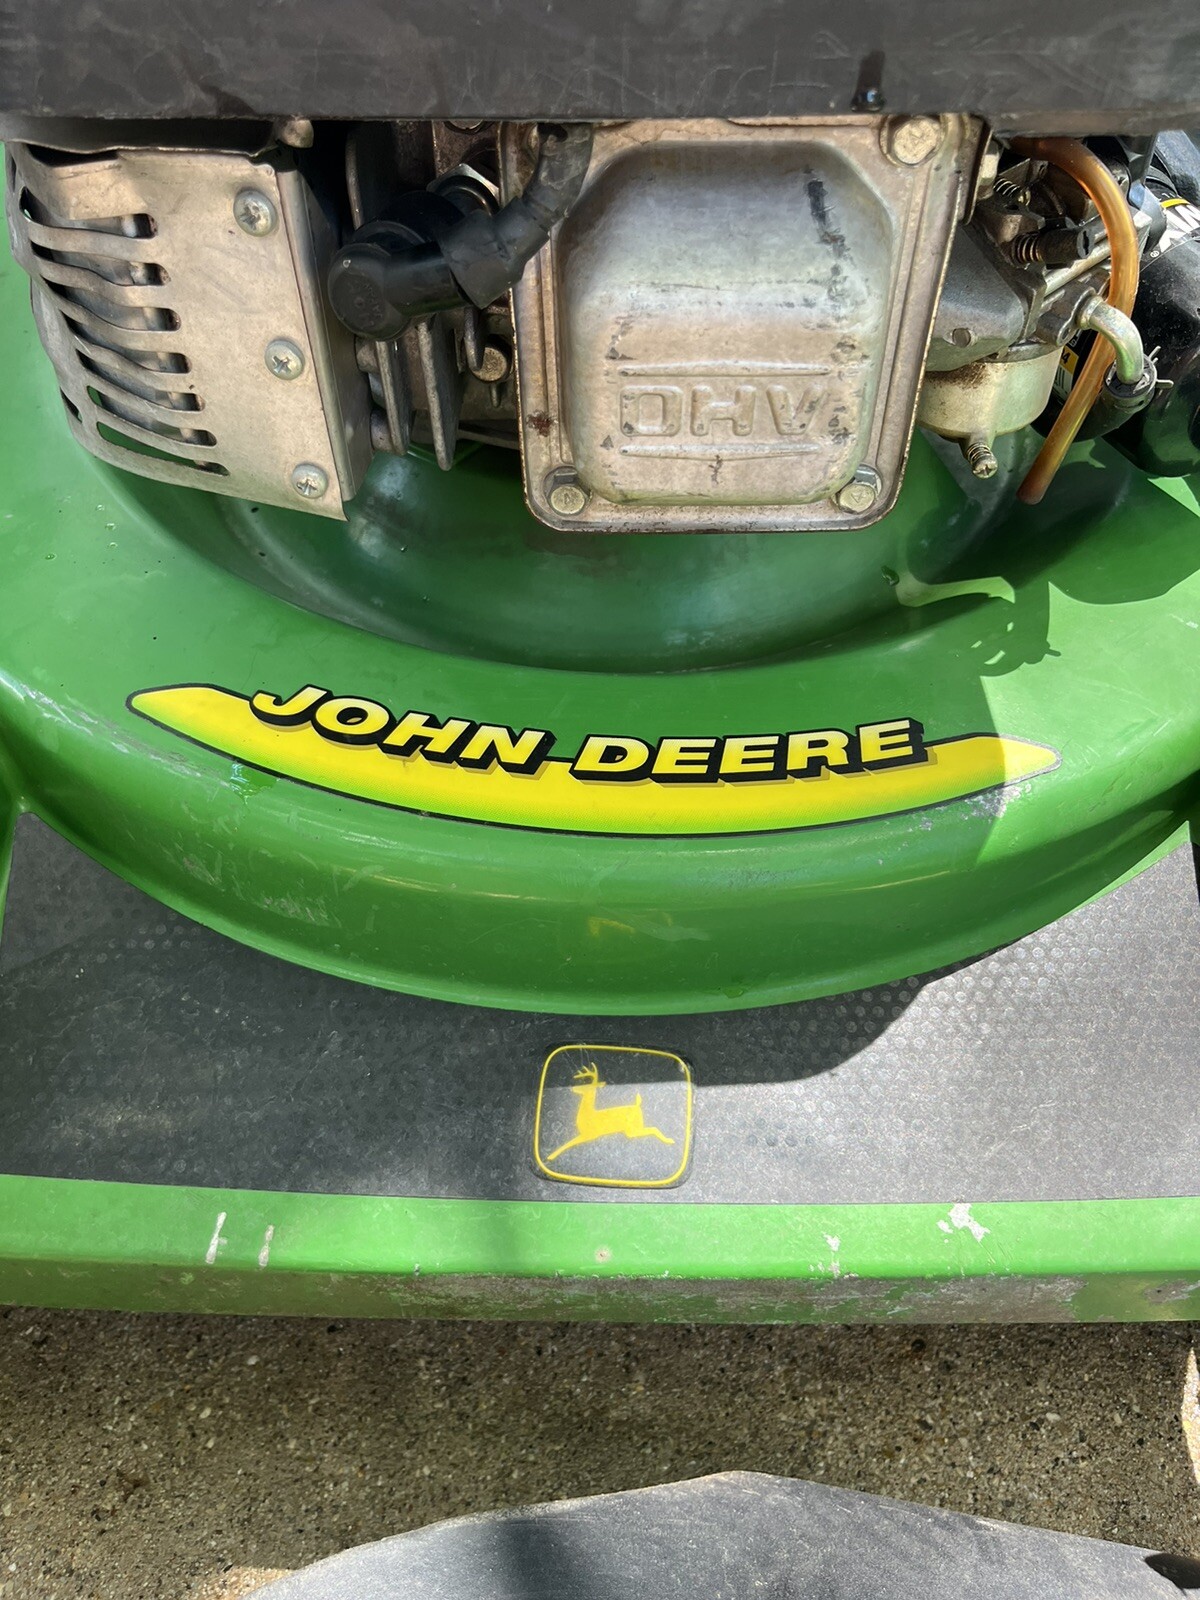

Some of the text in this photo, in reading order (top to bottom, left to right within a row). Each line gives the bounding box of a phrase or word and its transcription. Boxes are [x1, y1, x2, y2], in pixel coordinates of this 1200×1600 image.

[619, 385, 828, 437] OHV
[249, 684, 928, 783] JOHN DEERE
